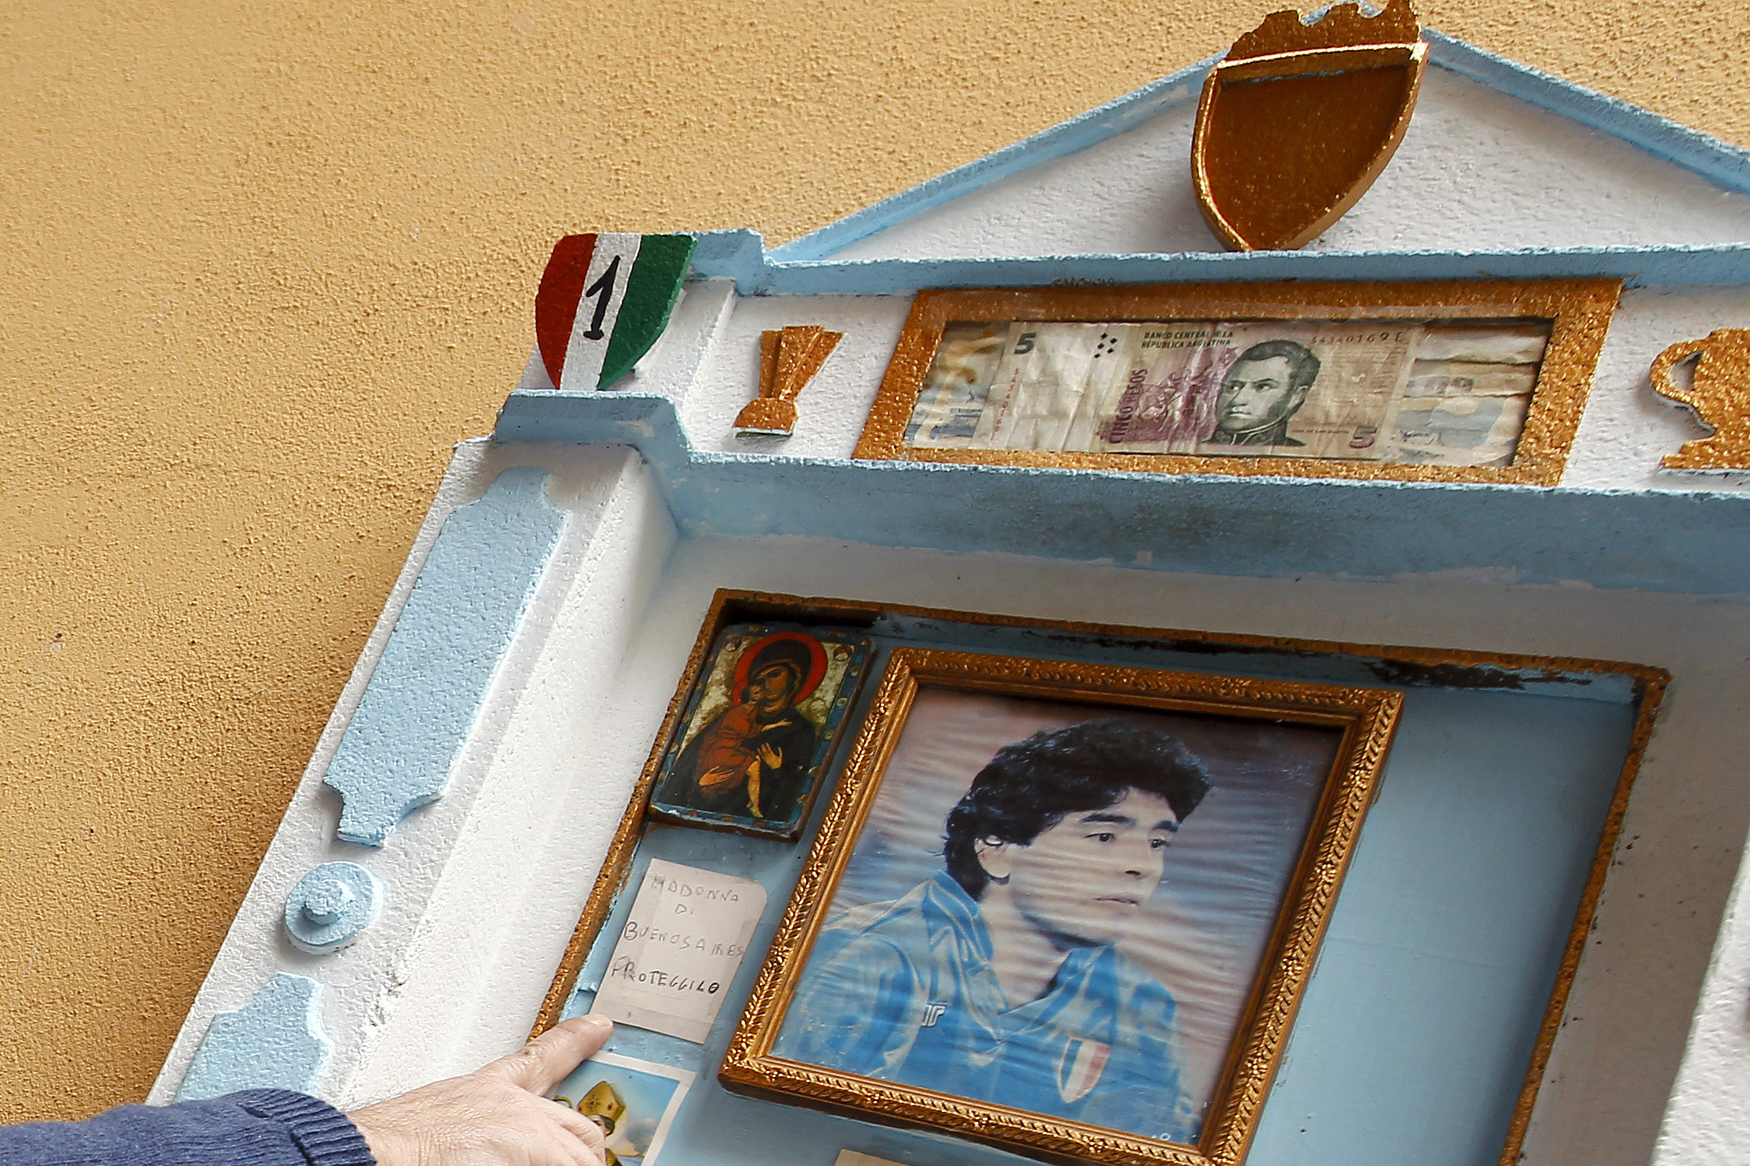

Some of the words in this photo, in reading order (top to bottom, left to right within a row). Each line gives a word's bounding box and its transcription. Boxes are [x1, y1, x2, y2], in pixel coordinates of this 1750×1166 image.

[583, 255, 621, 341] 1
[1013, 331, 1037, 354] 5
[1350, 426, 1378, 449] 5
[611, 955, 720, 994] PROTEGGILO
